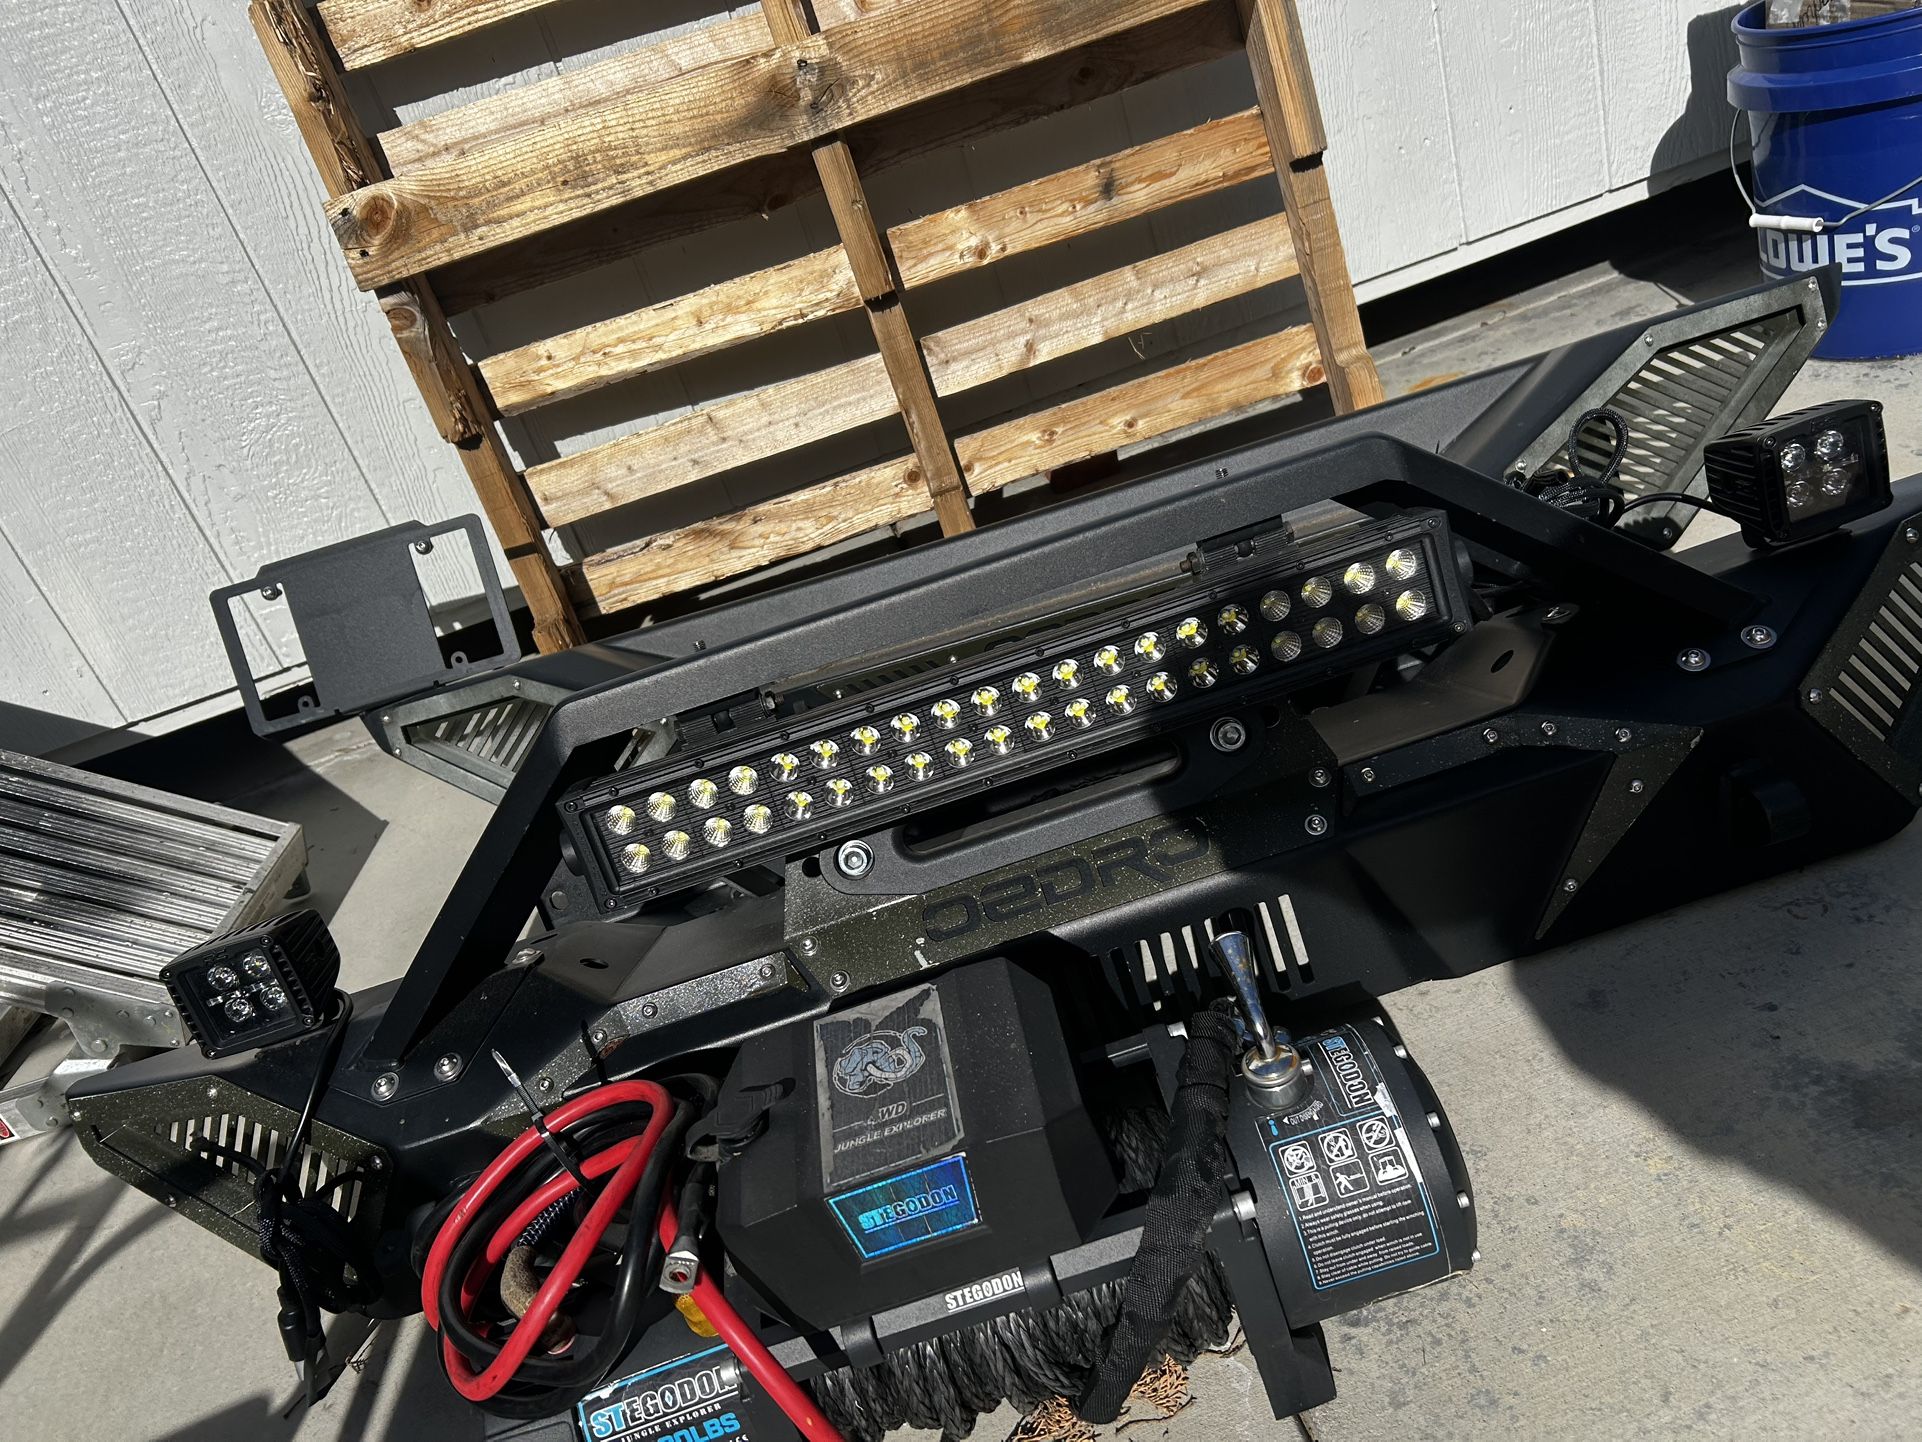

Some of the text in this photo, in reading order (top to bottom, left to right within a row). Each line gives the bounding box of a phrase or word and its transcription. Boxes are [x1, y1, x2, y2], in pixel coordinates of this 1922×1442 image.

[1758, 223, 1912, 273] LOWE'S
[1322, 1036, 1374, 1108] STEGODON
[834, 1108, 947, 1153] JUNGLE EXPLORER
[859, 1184, 958, 1230] STEGODON
[945, 1271, 1024, 1310] STEGODON
[621, 1403, 722, 1442] JUNGLE EXPLORER
